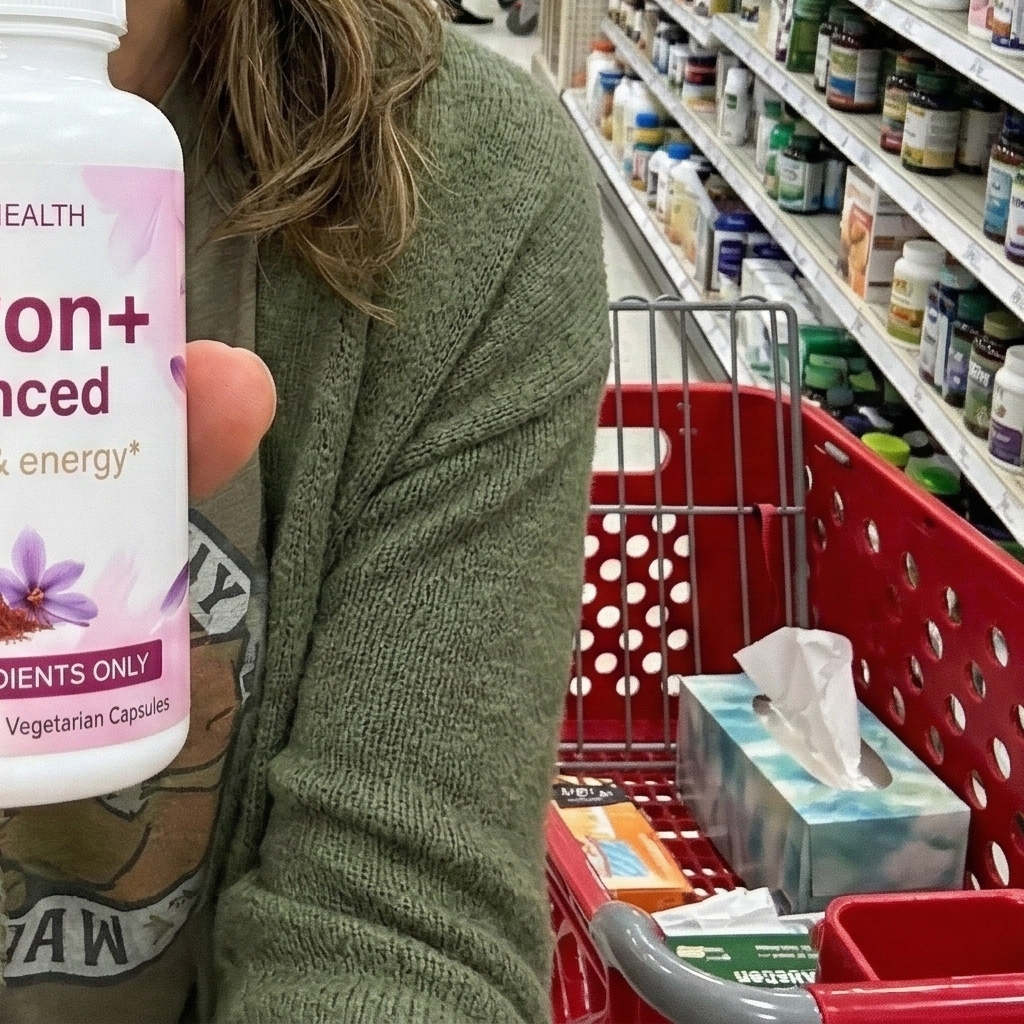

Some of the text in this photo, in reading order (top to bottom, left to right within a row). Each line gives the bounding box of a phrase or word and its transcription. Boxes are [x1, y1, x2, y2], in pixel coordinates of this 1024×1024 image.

[92, 651, 150, 683] ONLY
[5, 713, 104, 740] Vegetarian
[108, 694, 171, 726] Capsules
